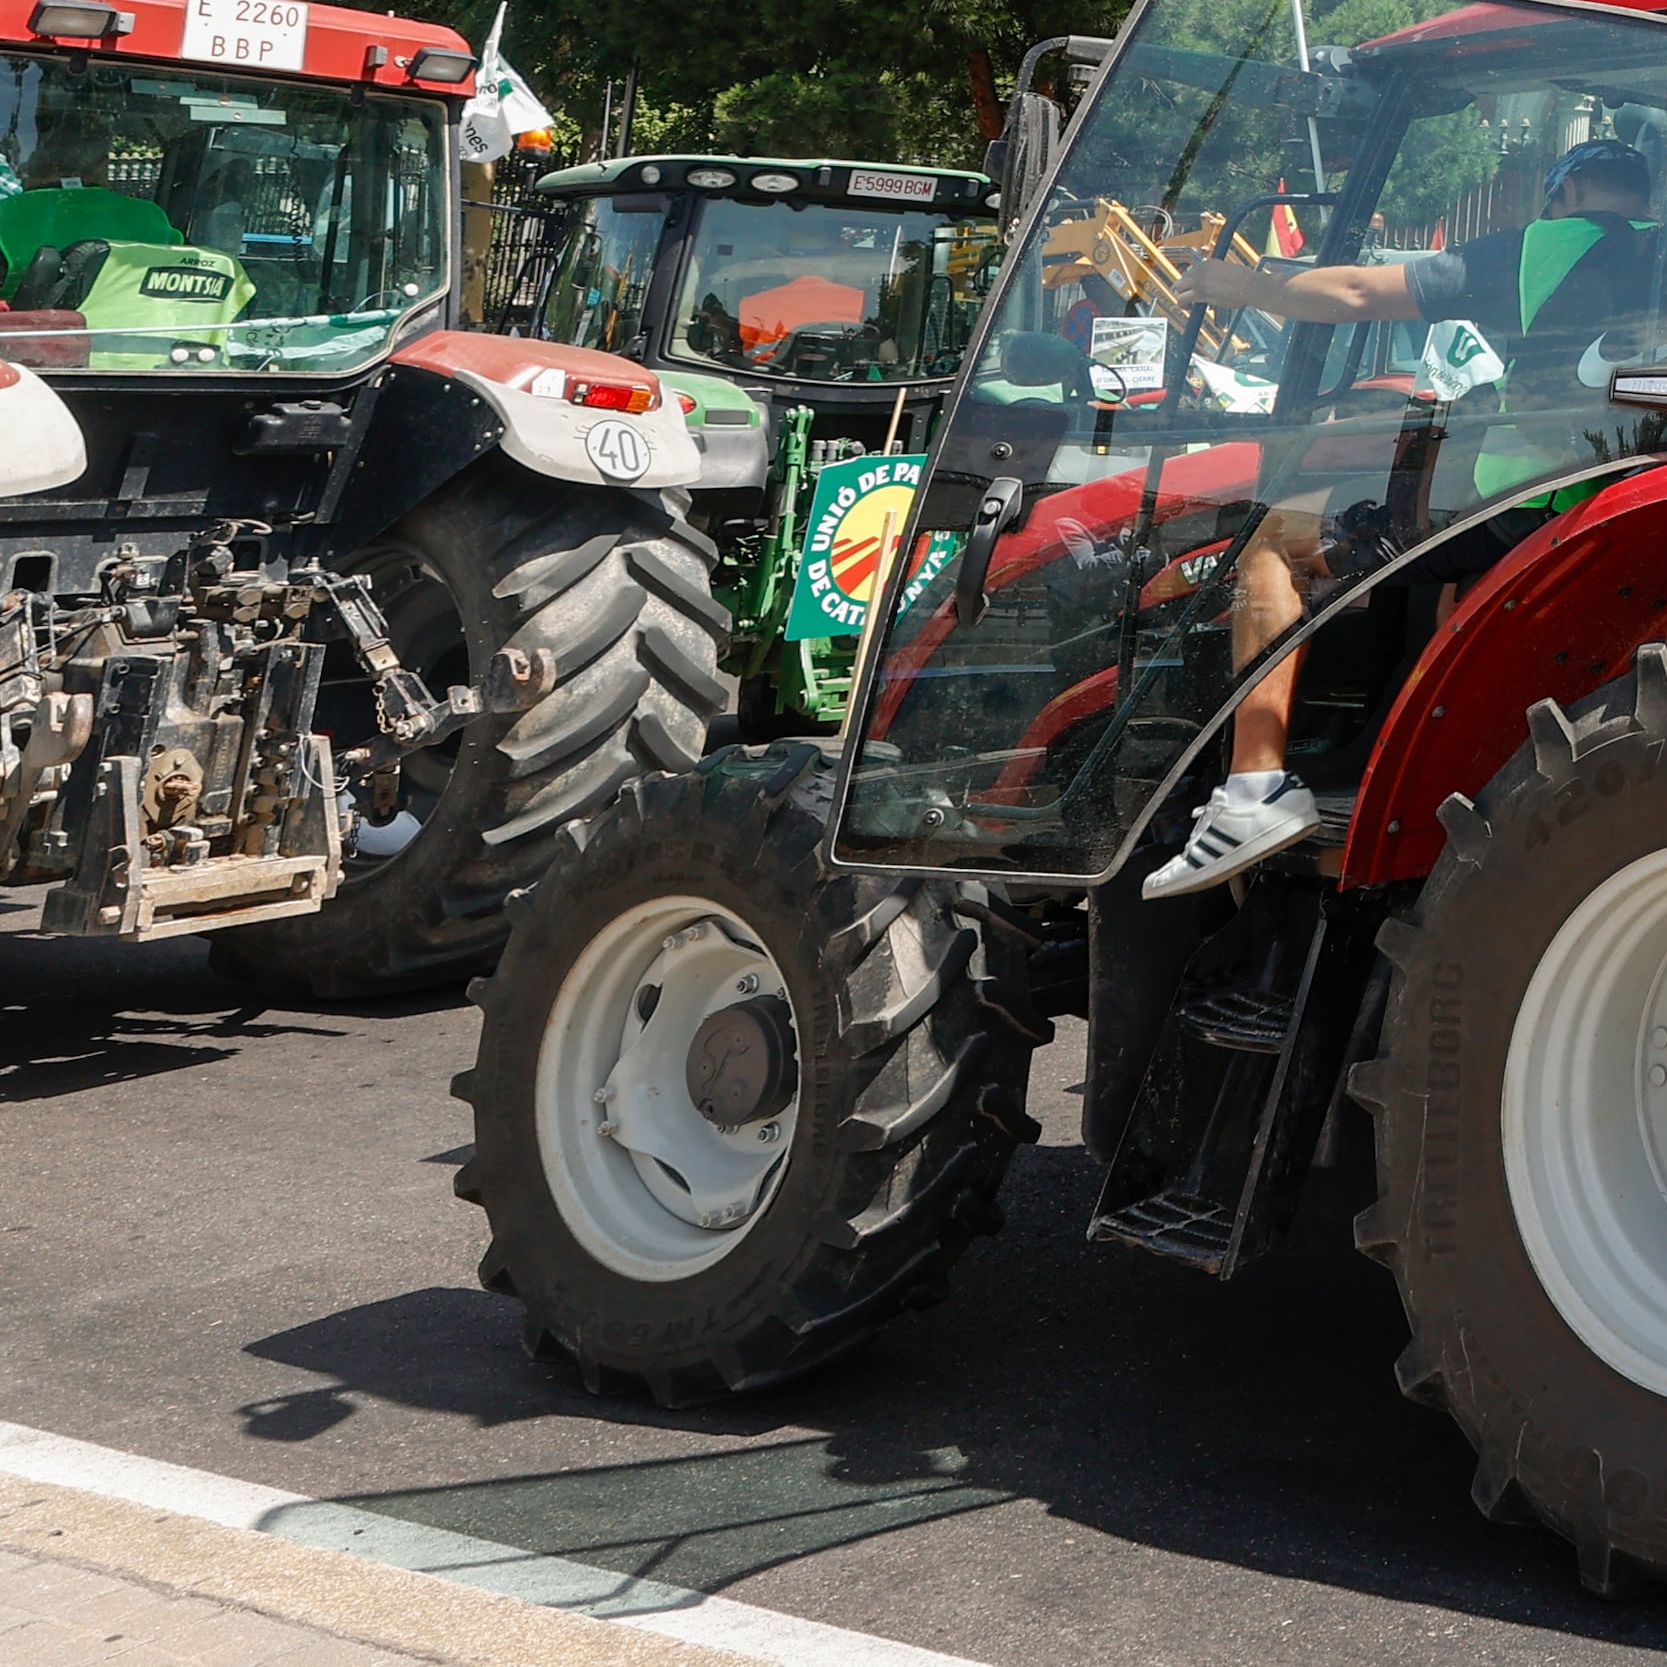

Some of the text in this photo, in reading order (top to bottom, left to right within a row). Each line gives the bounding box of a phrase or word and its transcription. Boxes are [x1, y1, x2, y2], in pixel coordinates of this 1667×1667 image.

[235, 0, 299, 28] 2260
[599, 427, 640, 472] 40
[811, 484, 858, 553] UNIÓ
[857, 463, 891, 495] DE
[807, 558, 829, 598] DE
